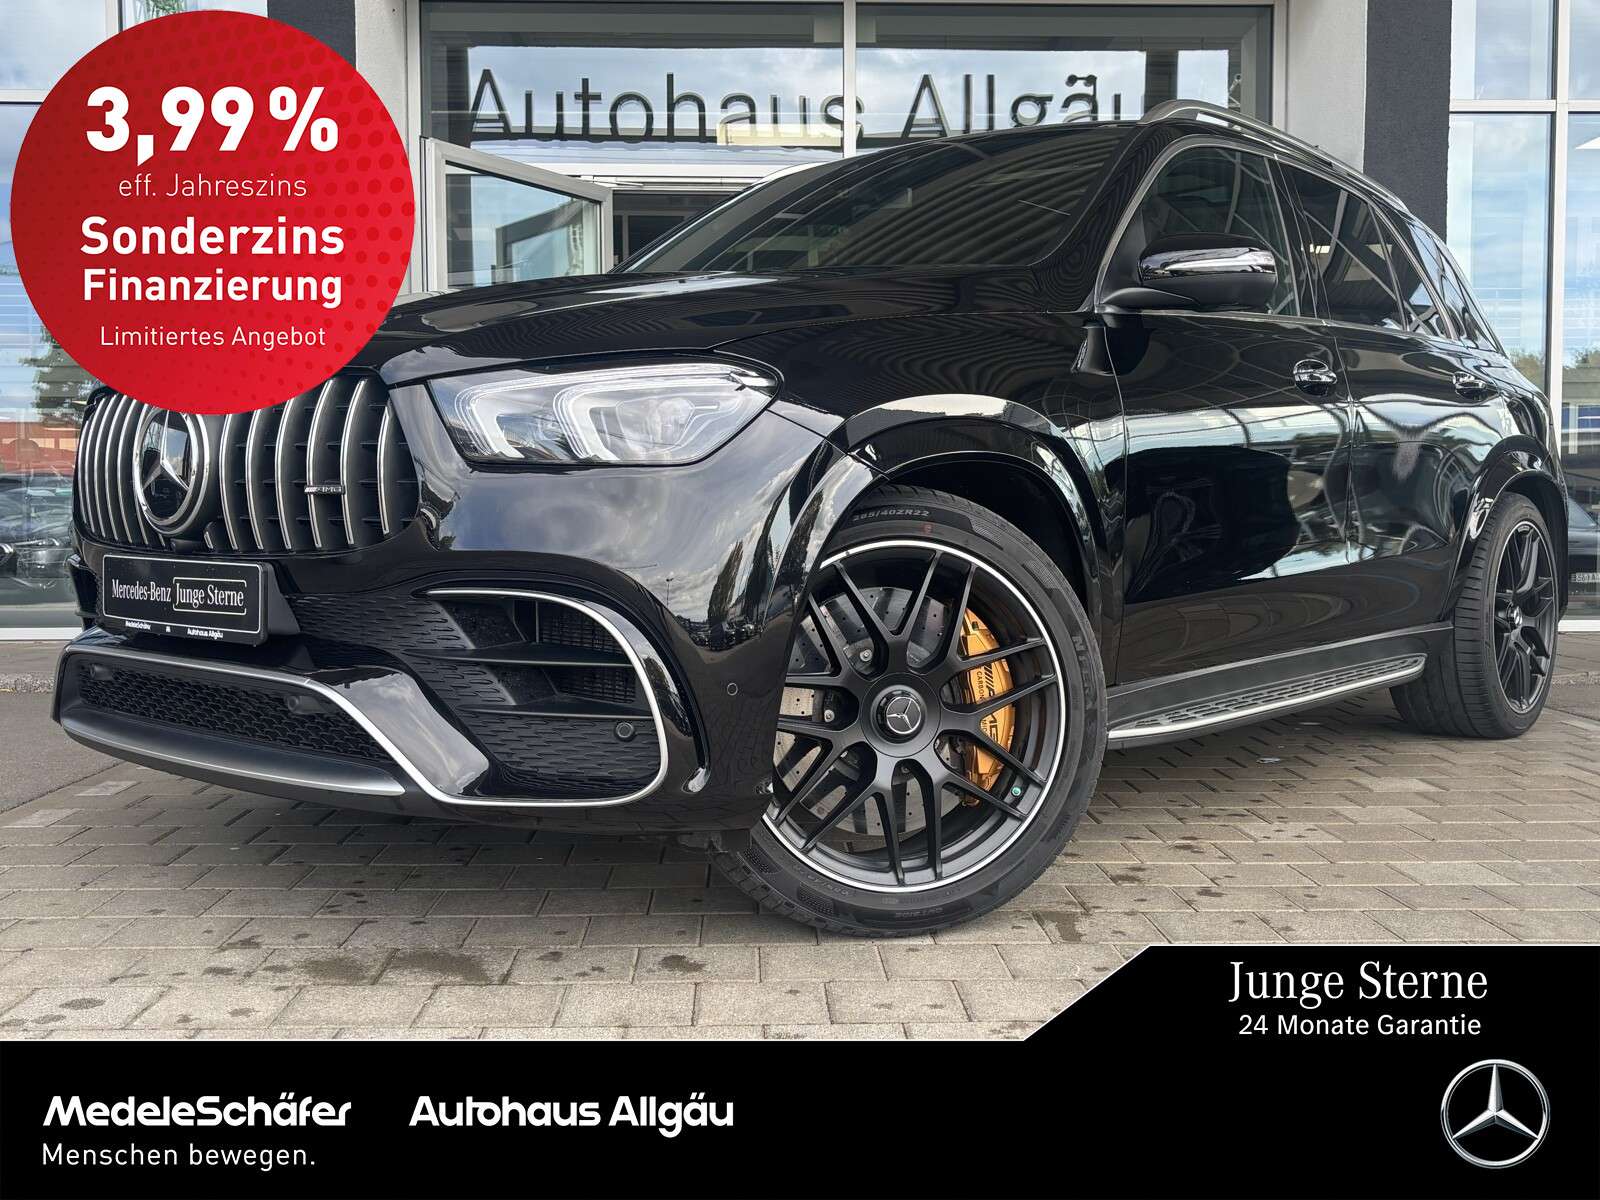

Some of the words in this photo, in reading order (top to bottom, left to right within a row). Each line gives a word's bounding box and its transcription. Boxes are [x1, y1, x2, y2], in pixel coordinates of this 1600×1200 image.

[468, 68, 865, 144] Autohaus
[111, 579, 171, 602] Mercedes-Benz
[175, 582, 205, 608] Junge
[207, 584, 244, 606] Sterne
